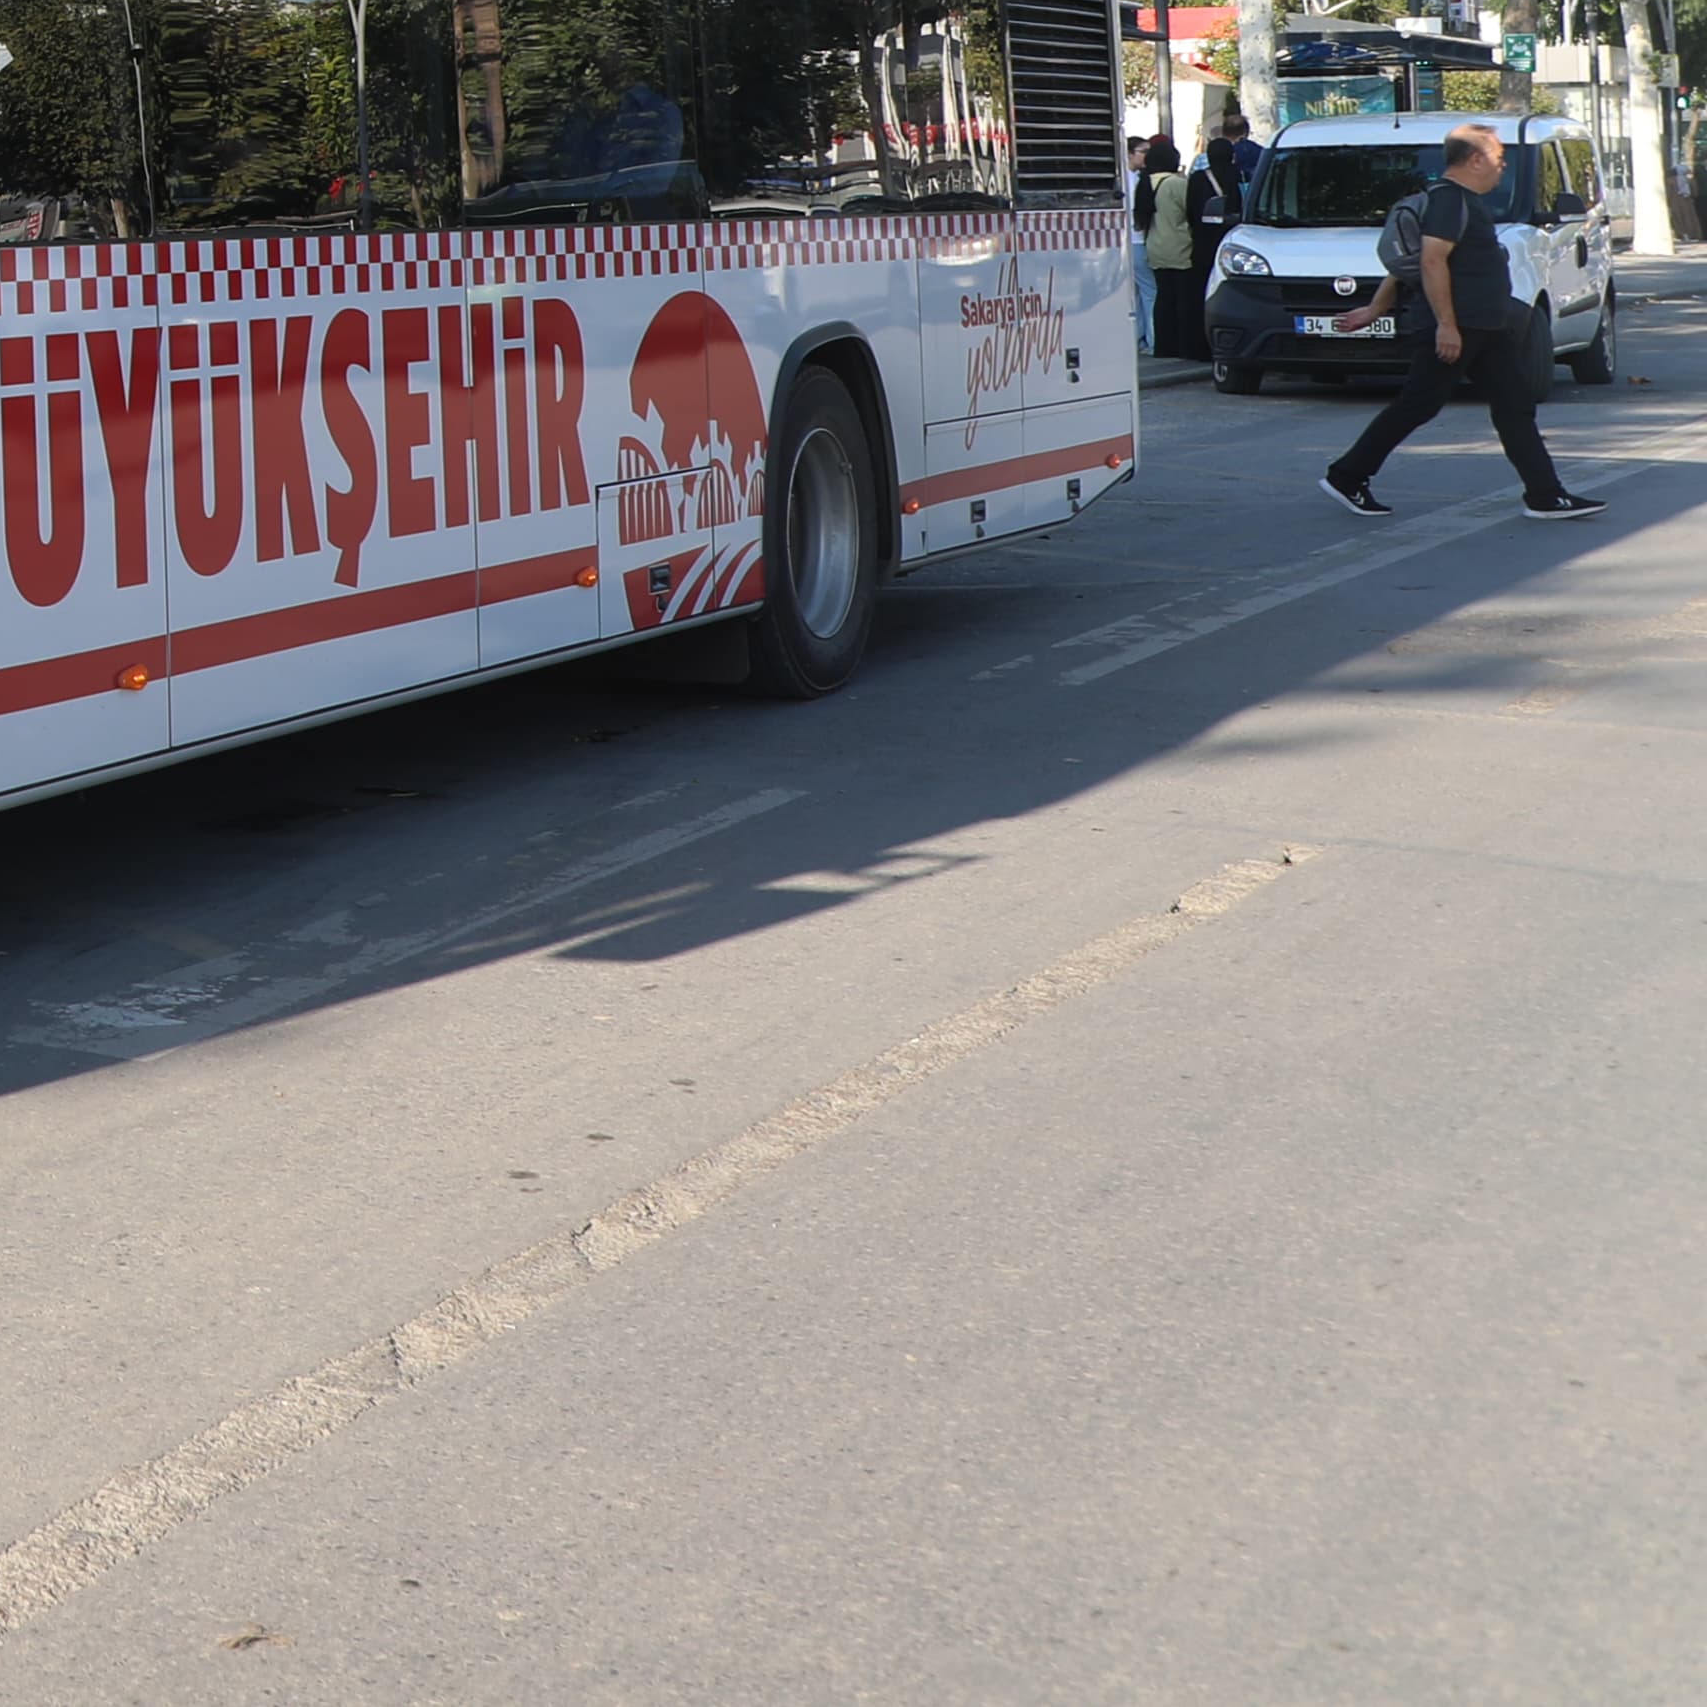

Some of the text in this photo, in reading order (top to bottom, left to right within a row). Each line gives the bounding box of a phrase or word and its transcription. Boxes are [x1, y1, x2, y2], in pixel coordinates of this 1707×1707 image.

[961, 286, 1043, 329] Sakarya için
[1306, 319, 1322, 332] 34
